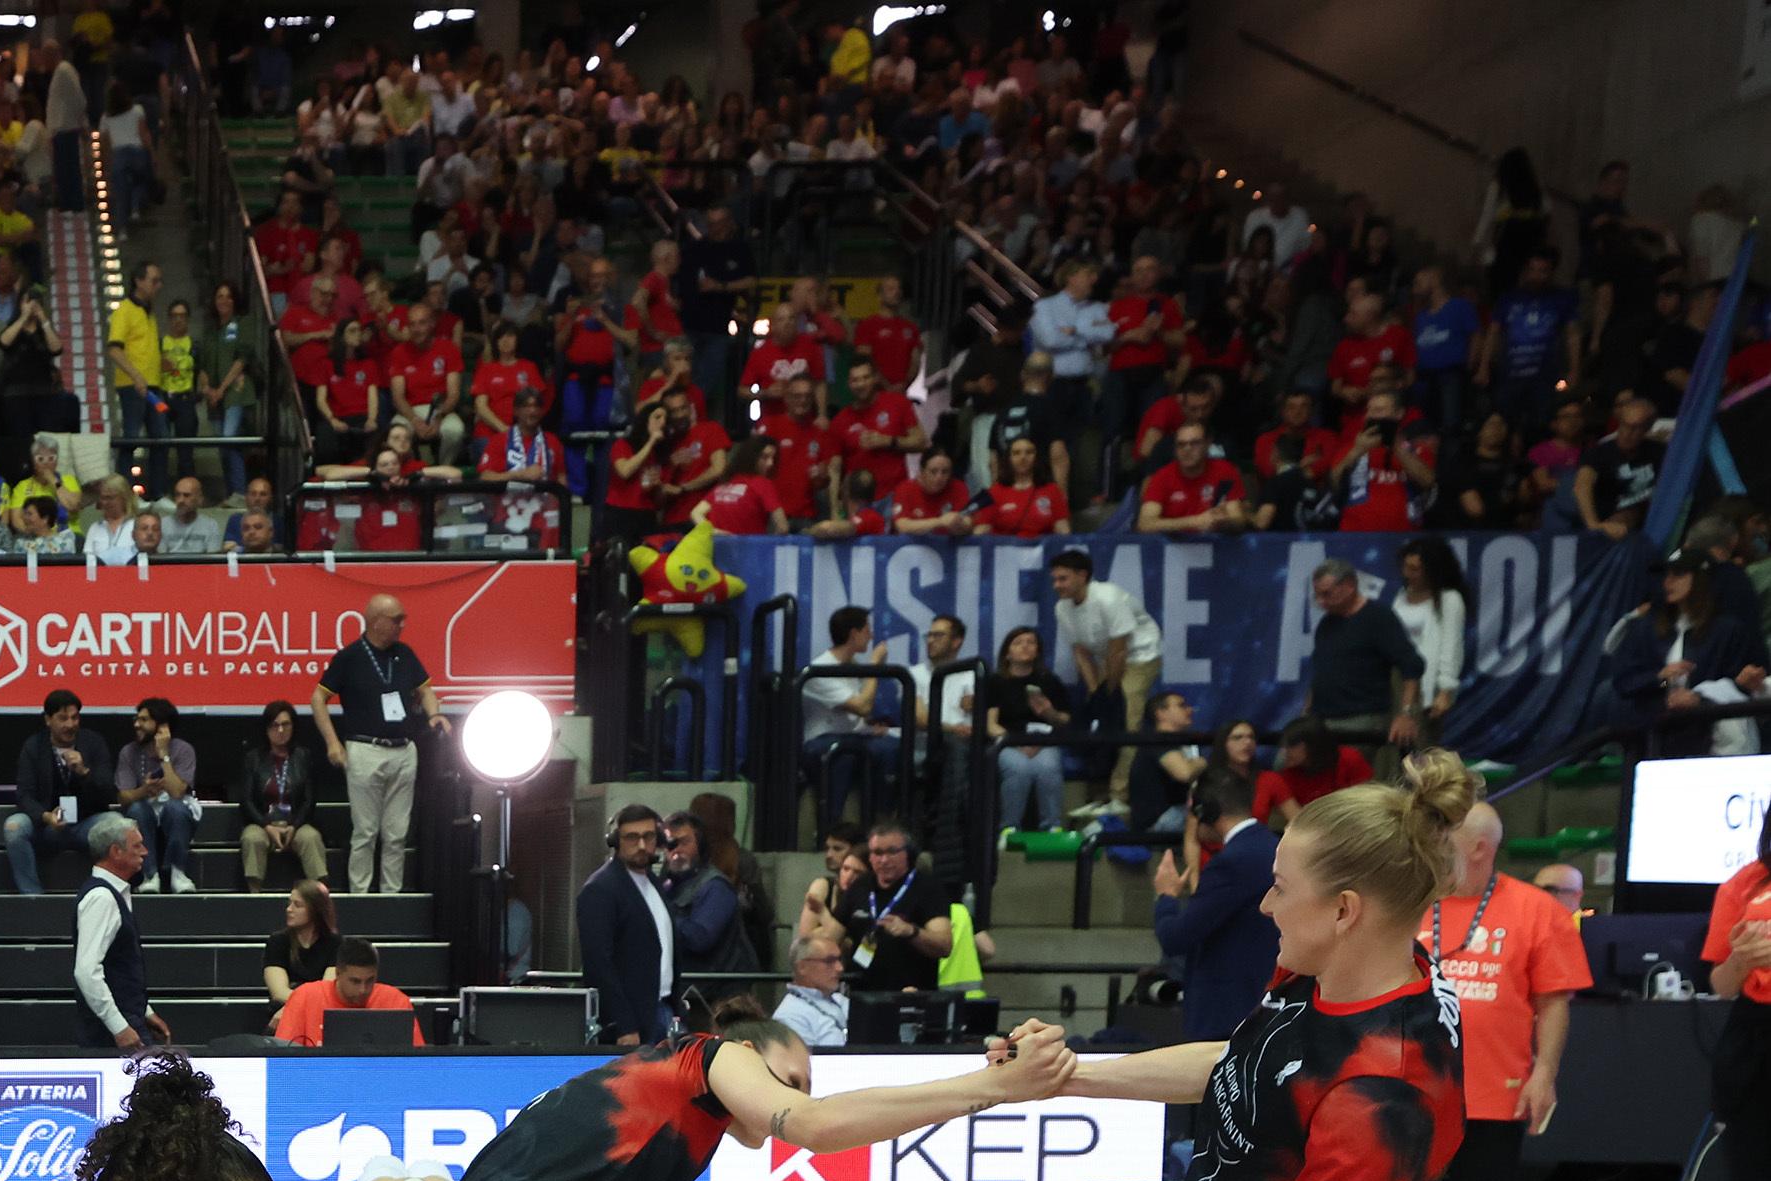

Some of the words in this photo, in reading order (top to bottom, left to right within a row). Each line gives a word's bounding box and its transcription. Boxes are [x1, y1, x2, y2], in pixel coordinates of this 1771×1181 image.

[37, 662, 60, 676] LA
[83, 659, 150, 676] CITTÀ
[165, 662, 209, 675] DEL
